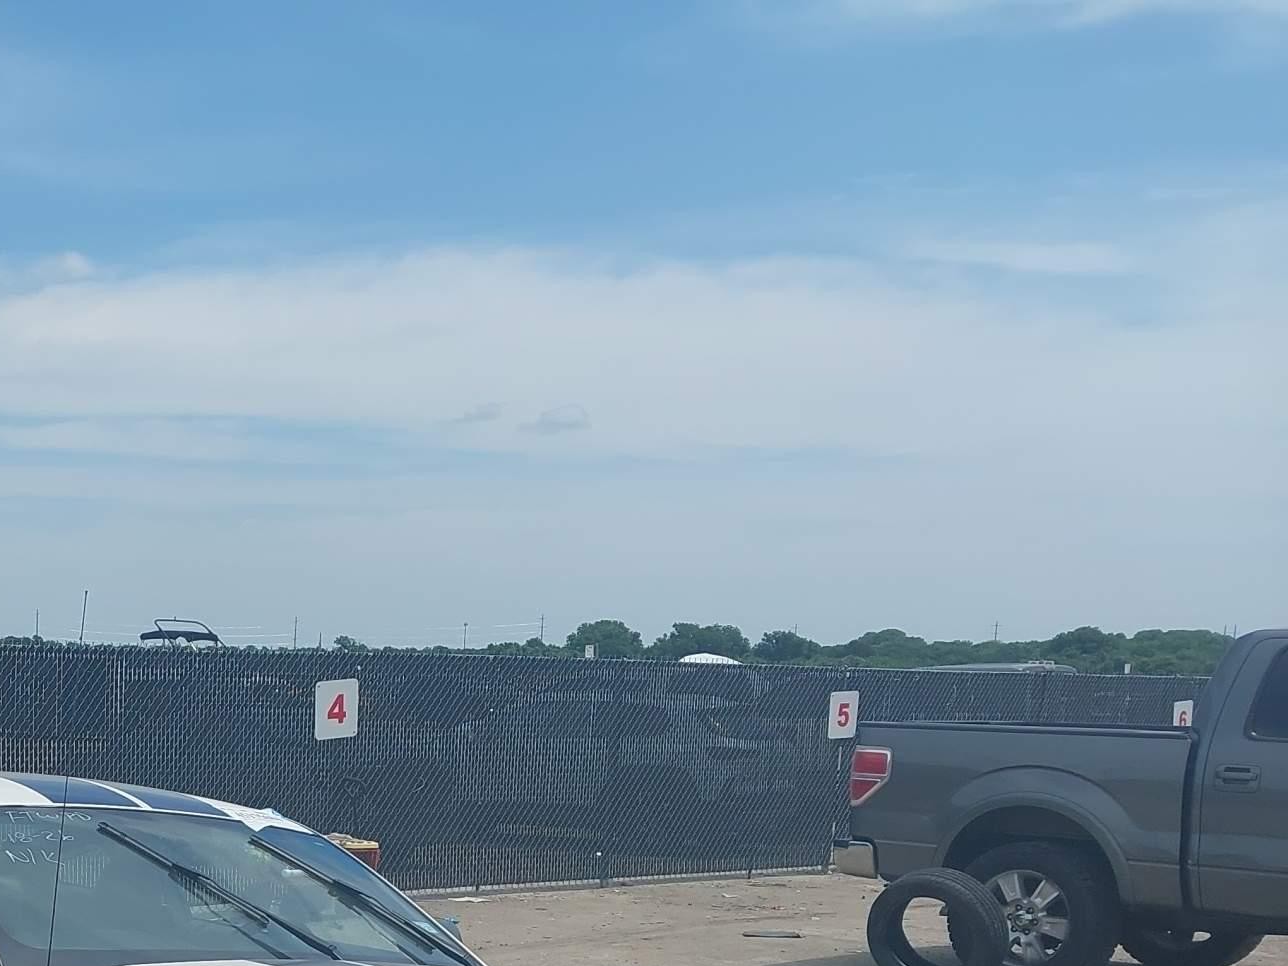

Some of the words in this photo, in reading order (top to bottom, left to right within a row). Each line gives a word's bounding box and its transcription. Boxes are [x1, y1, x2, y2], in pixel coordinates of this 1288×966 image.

[327, 693, 347, 724] 4
[837, 702, 850, 728] 5
[1179, 710, 1187, 726] 6
